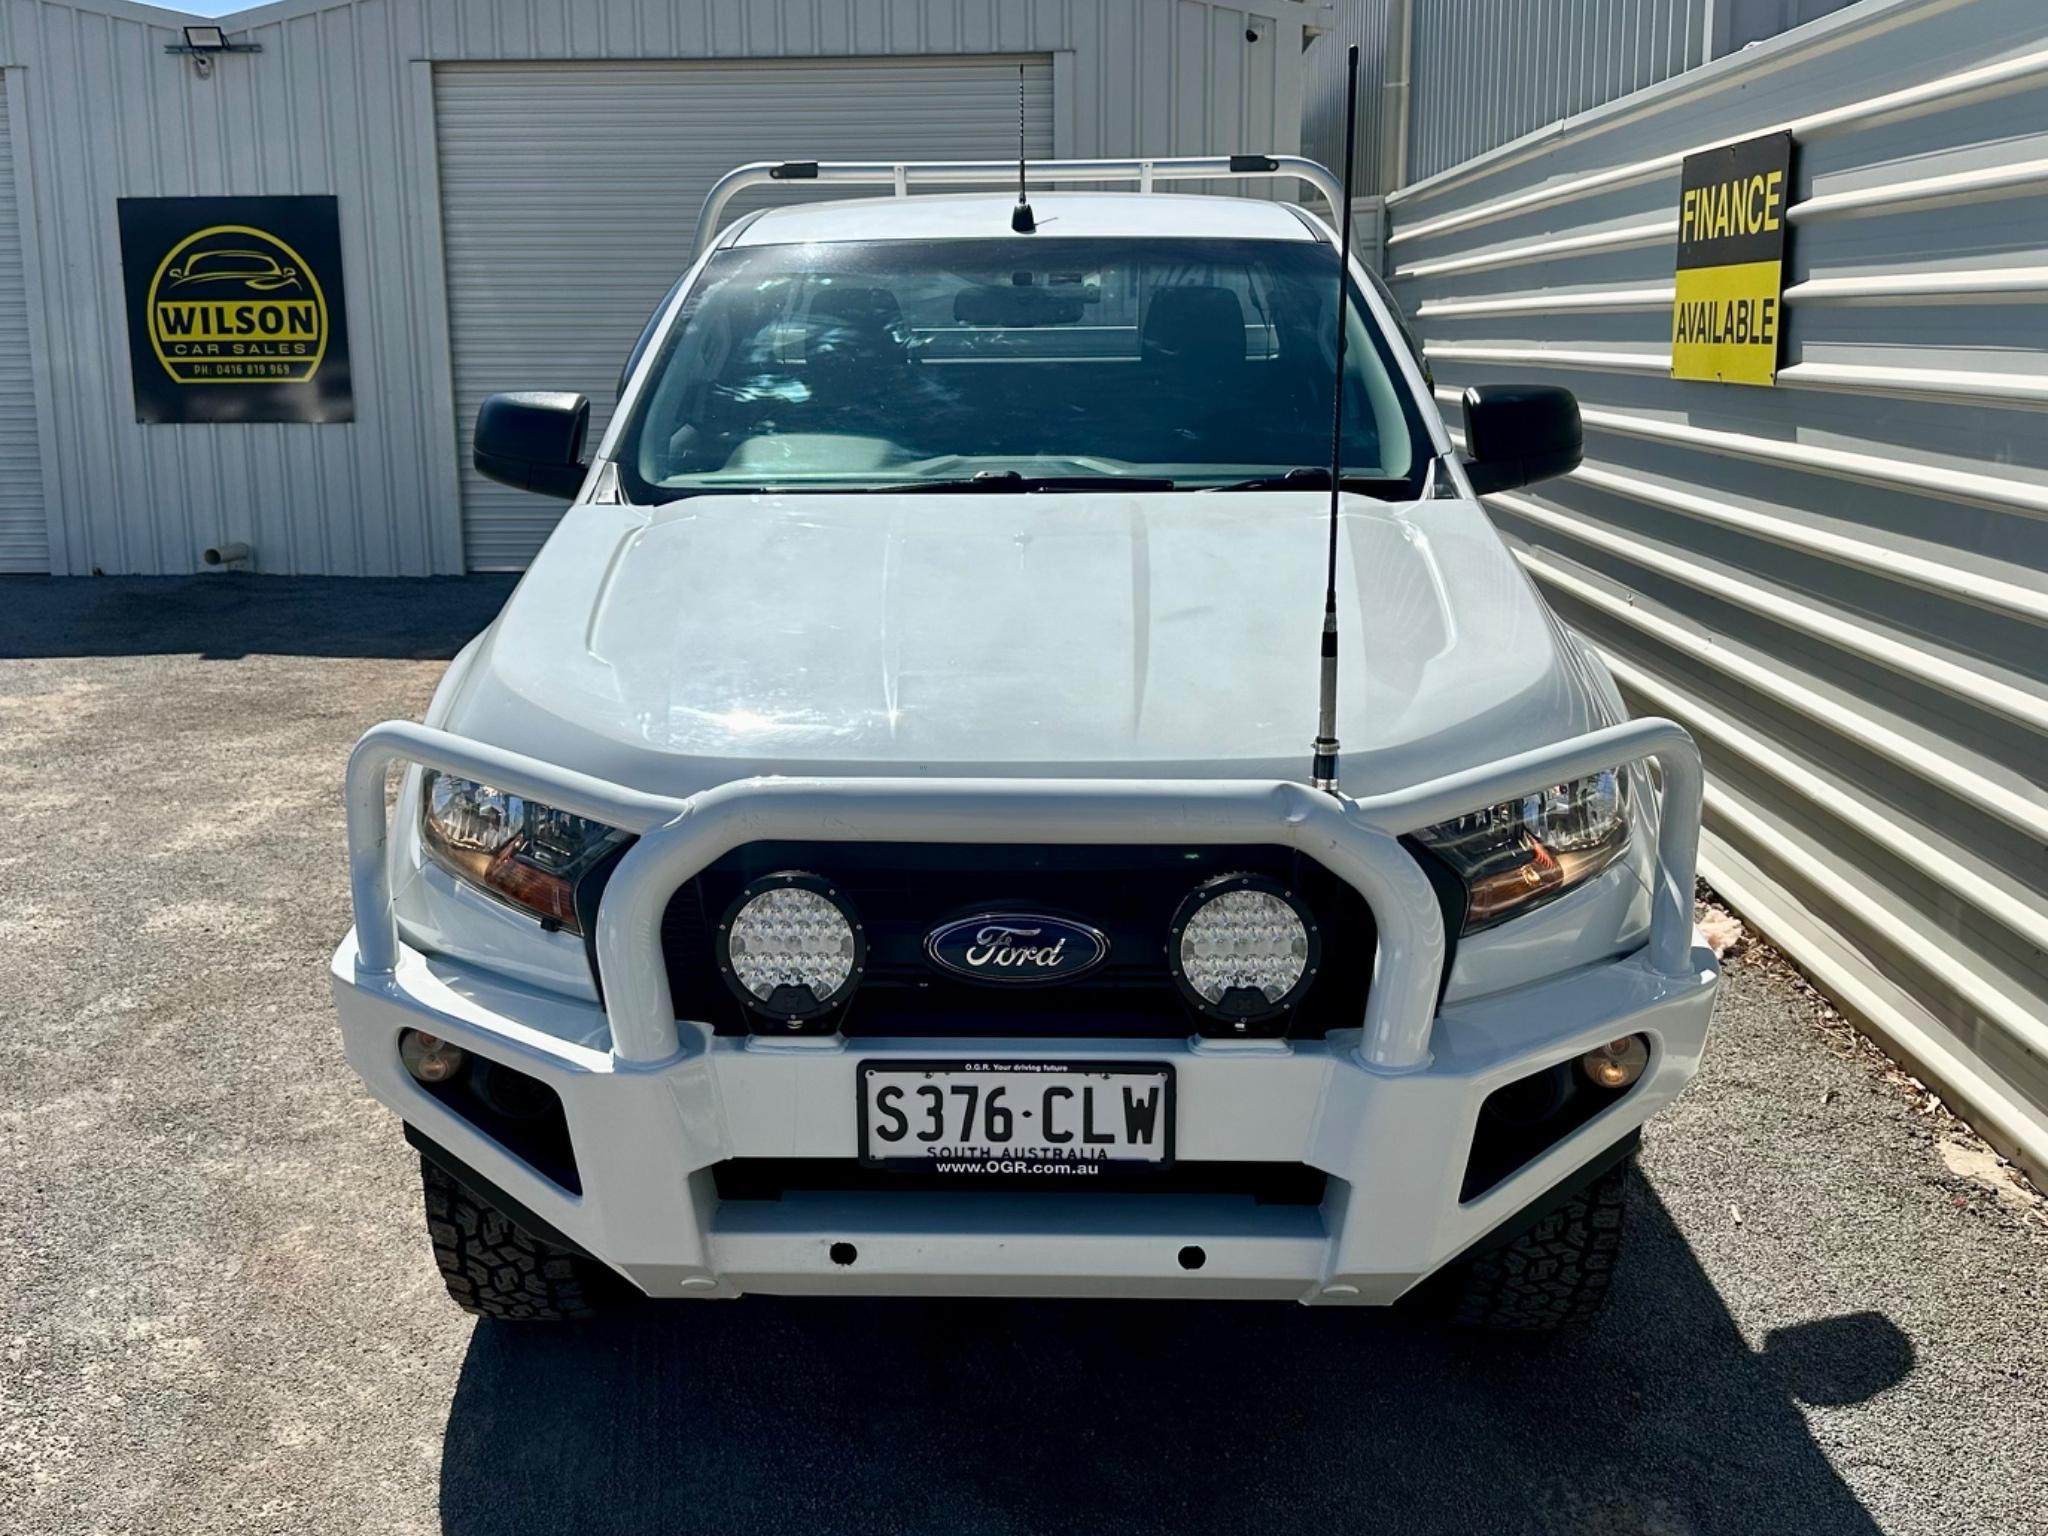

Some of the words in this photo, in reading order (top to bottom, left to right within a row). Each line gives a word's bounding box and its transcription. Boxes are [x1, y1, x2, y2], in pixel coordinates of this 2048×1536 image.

[1682, 170, 1782, 243] FINANCE
[160, 305, 315, 336] WILSON
[1676, 298, 1775, 345] AVAILABLE
[174, 343, 220, 355] CAR
[232, 343, 306, 354] SALES
[216, 364, 243, 375] 0416
[247, 364, 266, 375] 819
[270, 363, 290, 375] 969
[966, 926, 1067, 967] Ford
[964, 1063, 991, 1072] O.G.R.
[993, 1063, 1012, 1072] Your
[1013, 1063, 1041, 1073] driving
[1043, 1063, 1069, 1072] future
[926, 1146, 991, 1159] SOUTH
[1001, 1147, 1108, 1160] AUSTRALIA
[936, 1160, 1099, 1175] www.OGR.com.au
